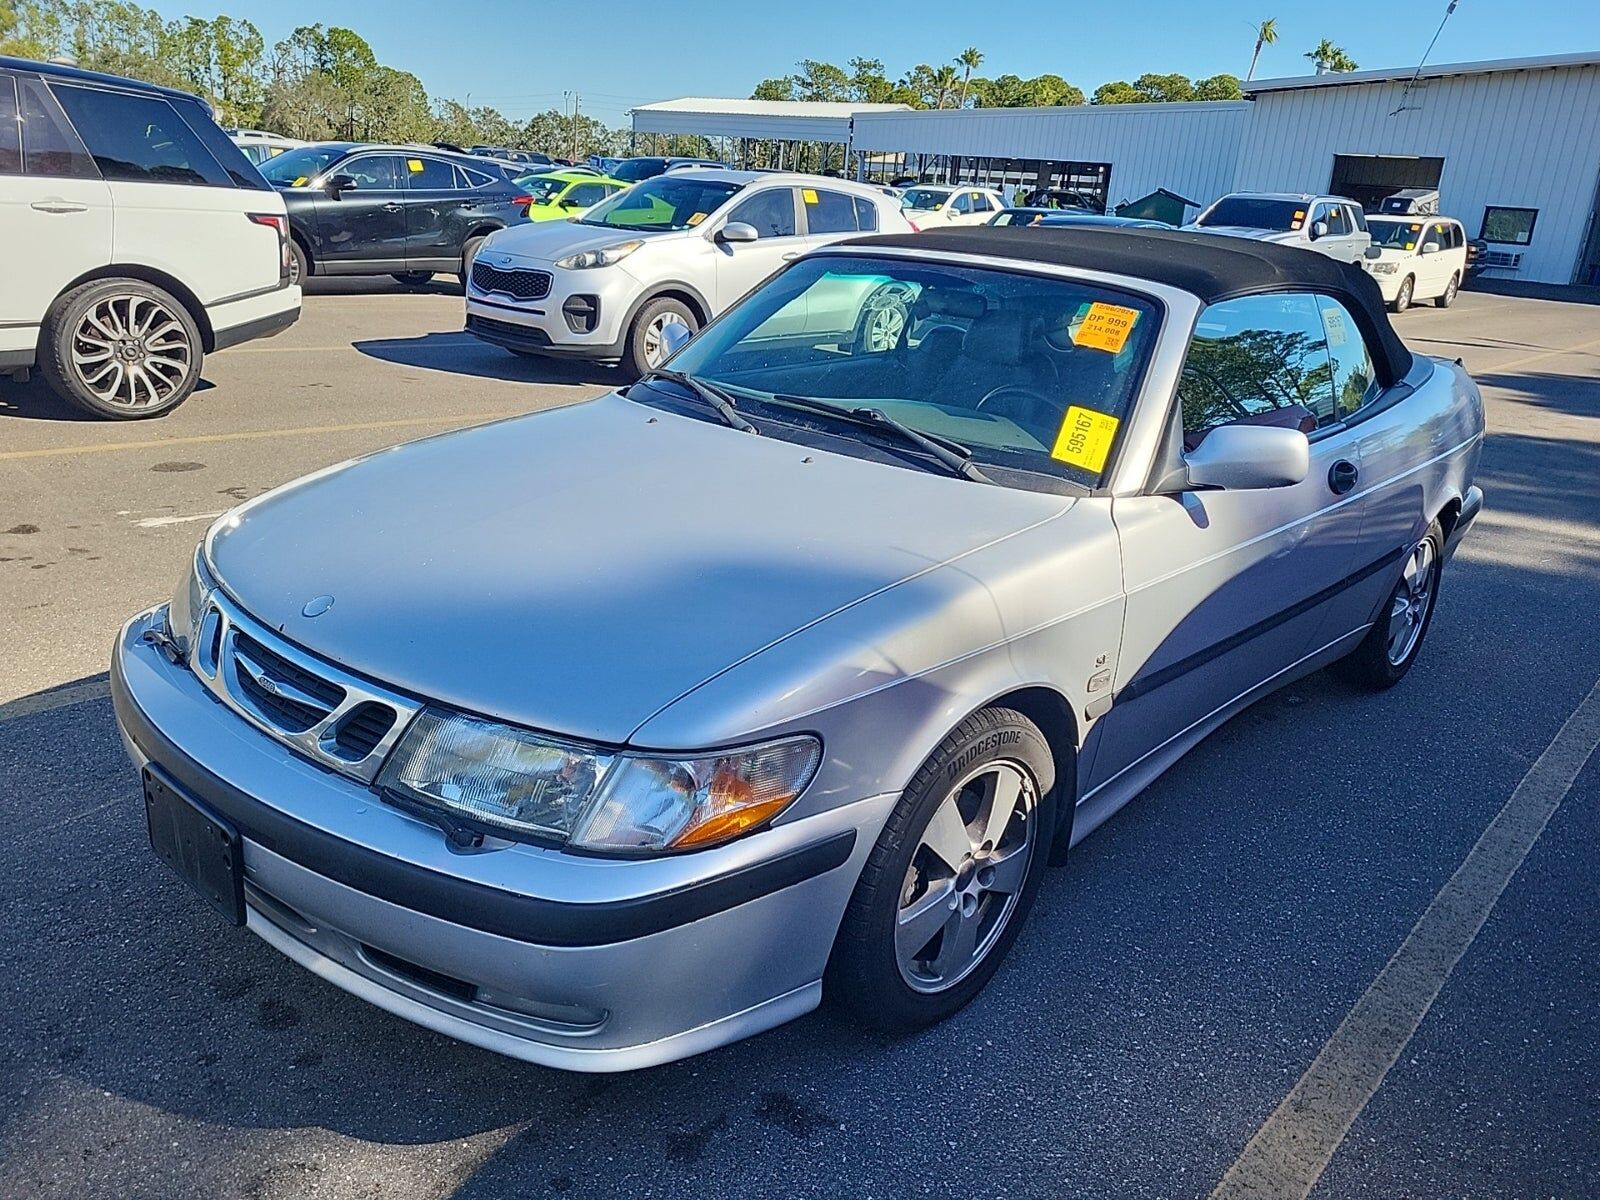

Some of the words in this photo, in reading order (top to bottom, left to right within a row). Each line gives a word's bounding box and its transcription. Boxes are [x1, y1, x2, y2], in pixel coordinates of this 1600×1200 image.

[1088, 313, 1105, 323] DP
[1106, 316, 1128, 328] 999
[1066, 411, 1094, 455] 595167
[946, 730, 1022, 781] BRIDGESTONE
